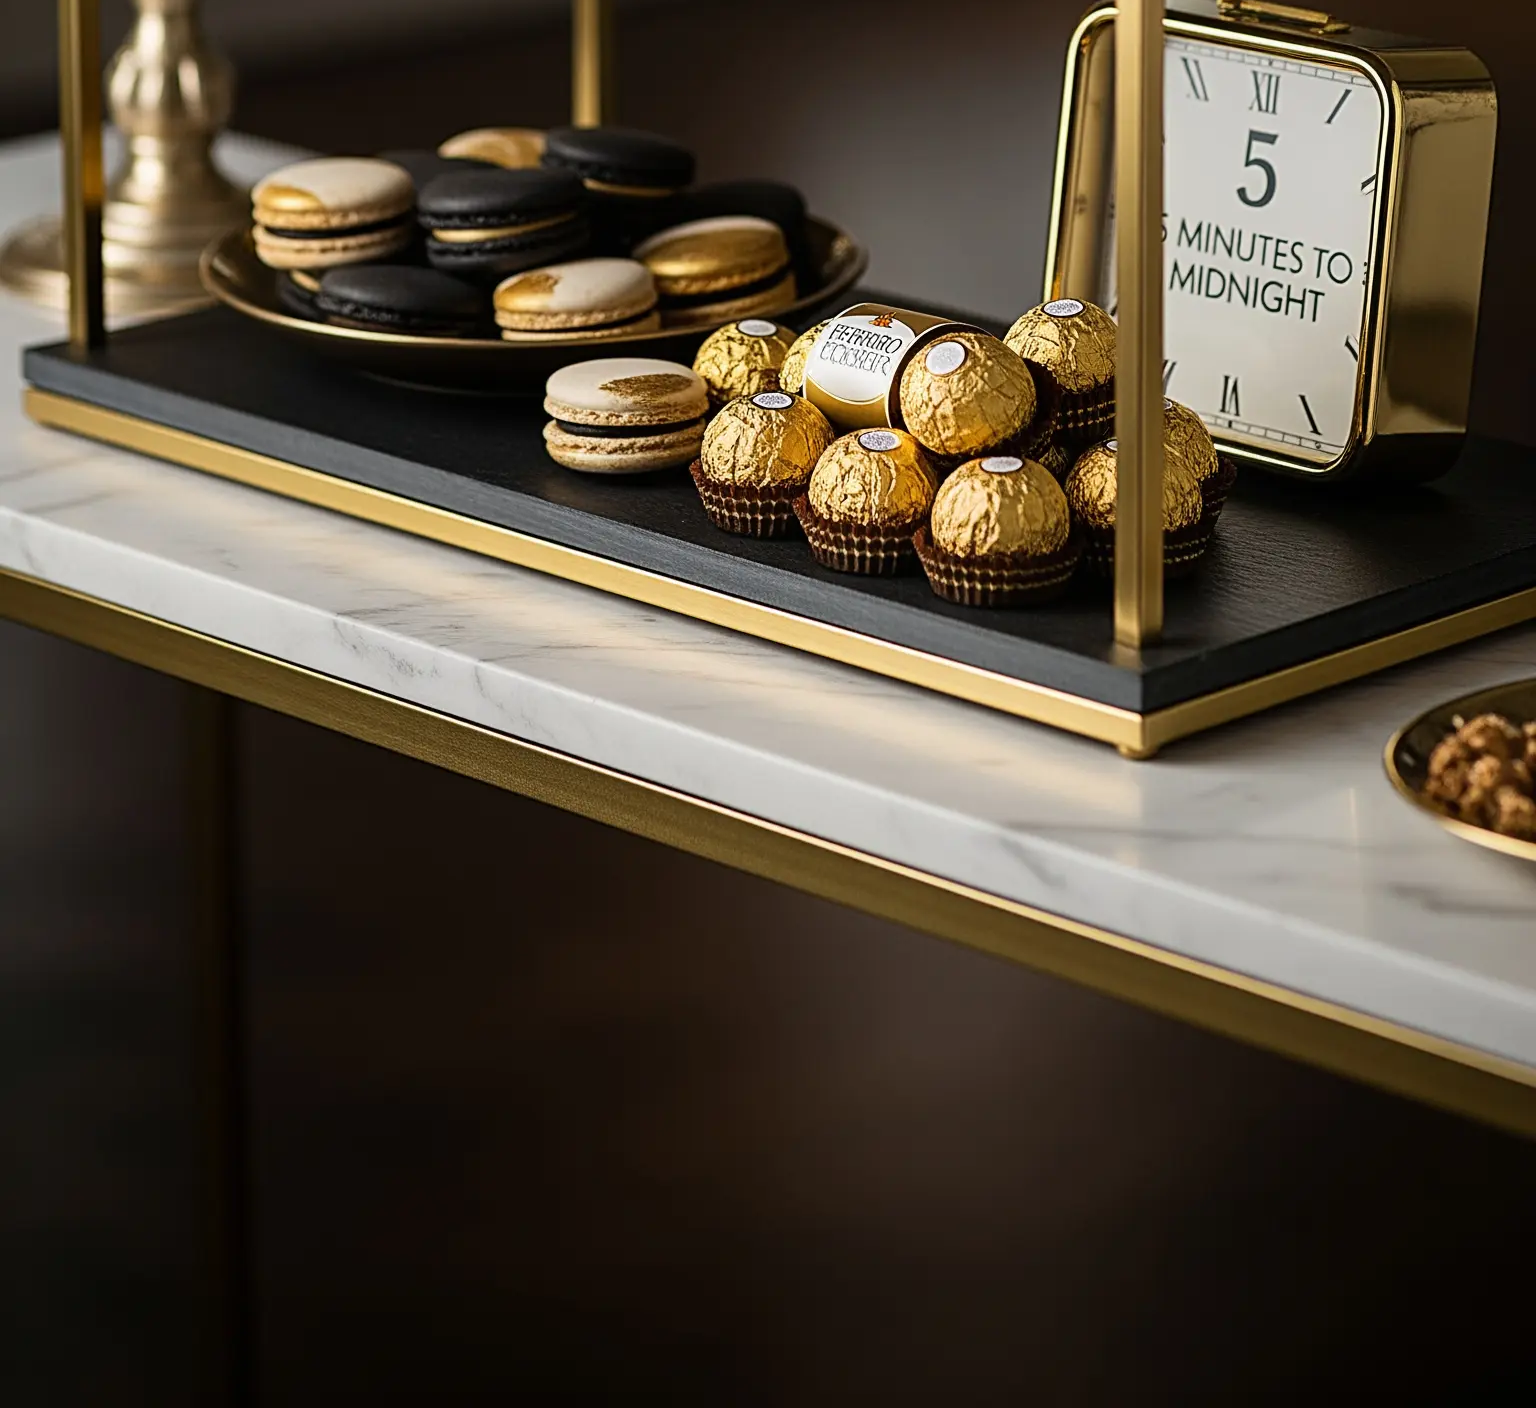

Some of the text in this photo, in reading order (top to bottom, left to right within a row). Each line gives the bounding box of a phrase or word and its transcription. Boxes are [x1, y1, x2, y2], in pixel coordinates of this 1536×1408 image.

[1248, 69, 1281, 115] XII
[1236, 128, 1279, 208] 5
[1177, 217, 1304, 274] MINUTES
[1312, 246, 1353, 285] TO
[1168, 258, 1326, 323] MIDNIGHT
